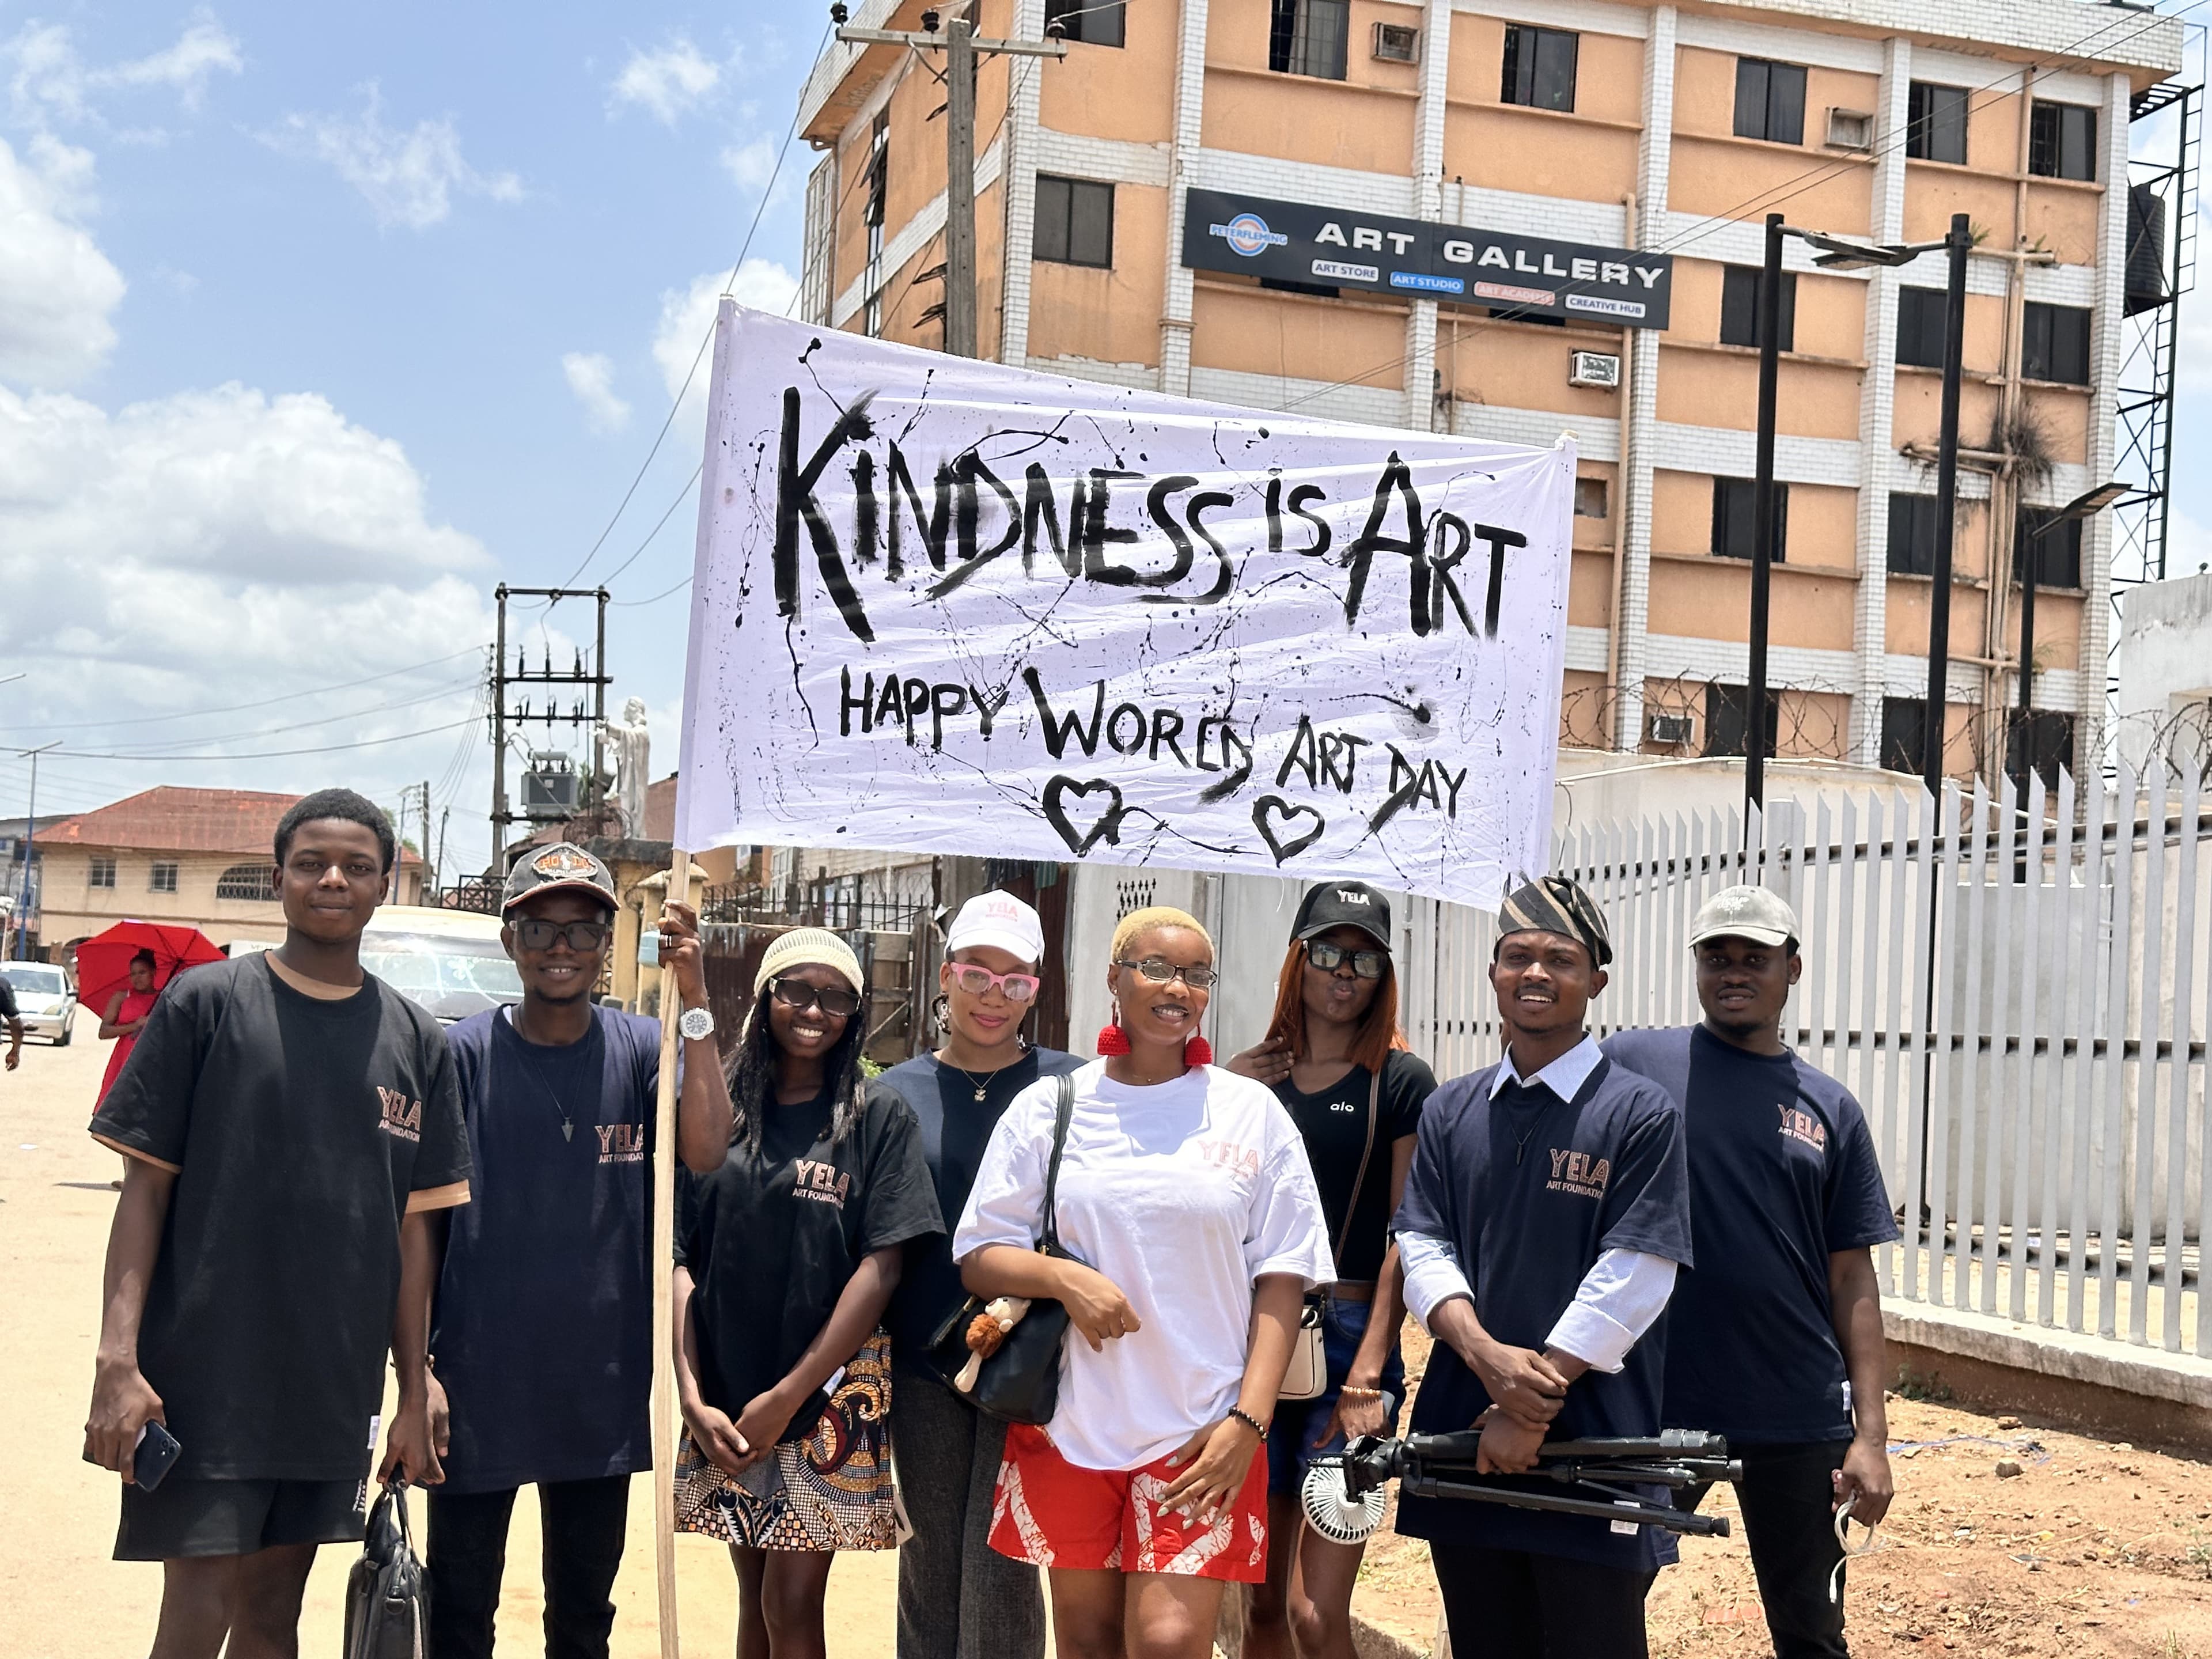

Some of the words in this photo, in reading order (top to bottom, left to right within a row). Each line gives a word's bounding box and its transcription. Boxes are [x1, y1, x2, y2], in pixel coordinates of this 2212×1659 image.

[1211, 225, 1287, 243] PETERFLEMING
[1314, 222, 1415, 255] ART
[1443, 240, 1664, 289] GALLERY
[1315, 263, 1338, 275] ART
[1340, 266, 1376, 278] STORE
[1393, 275, 1417, 286] ART
[1418, 278, 1461, 291] STUDIO
[1478, 285, 1499, 296] ART
[1569, 299, 1618, 311] CREATIVE
[1620, 305, 1642, 315] HUB
[774, 386, 1234, 643] KINDNESS
[1266, 477, 1332, 556] IS
[1340, 450, 1528, 643] ART
[840, 664, 1010, 753] HAPPY
[1275, 715, 1373, 794] ART
[1369, 742, 1467, 831] DAY
[1337, 889, 1370, 906] YELA
[377, 1086, 422, 1131] YELA
[1330, 1101, 1354, 1112] alo
[1777, 1103, 1825, 1147] YELA
[1778, 1126, 1793, 1136] ART
[594, 1124, 643, 1153] YELA
[599, 1154, 613, 1164] ART
[1550, 1148, 1609, 1189] YELA
[796, 1160, 850, 1202] YELA
[1546, 1180, 1562, 1190] ART
[792, 1188, 808, 1198] ART
